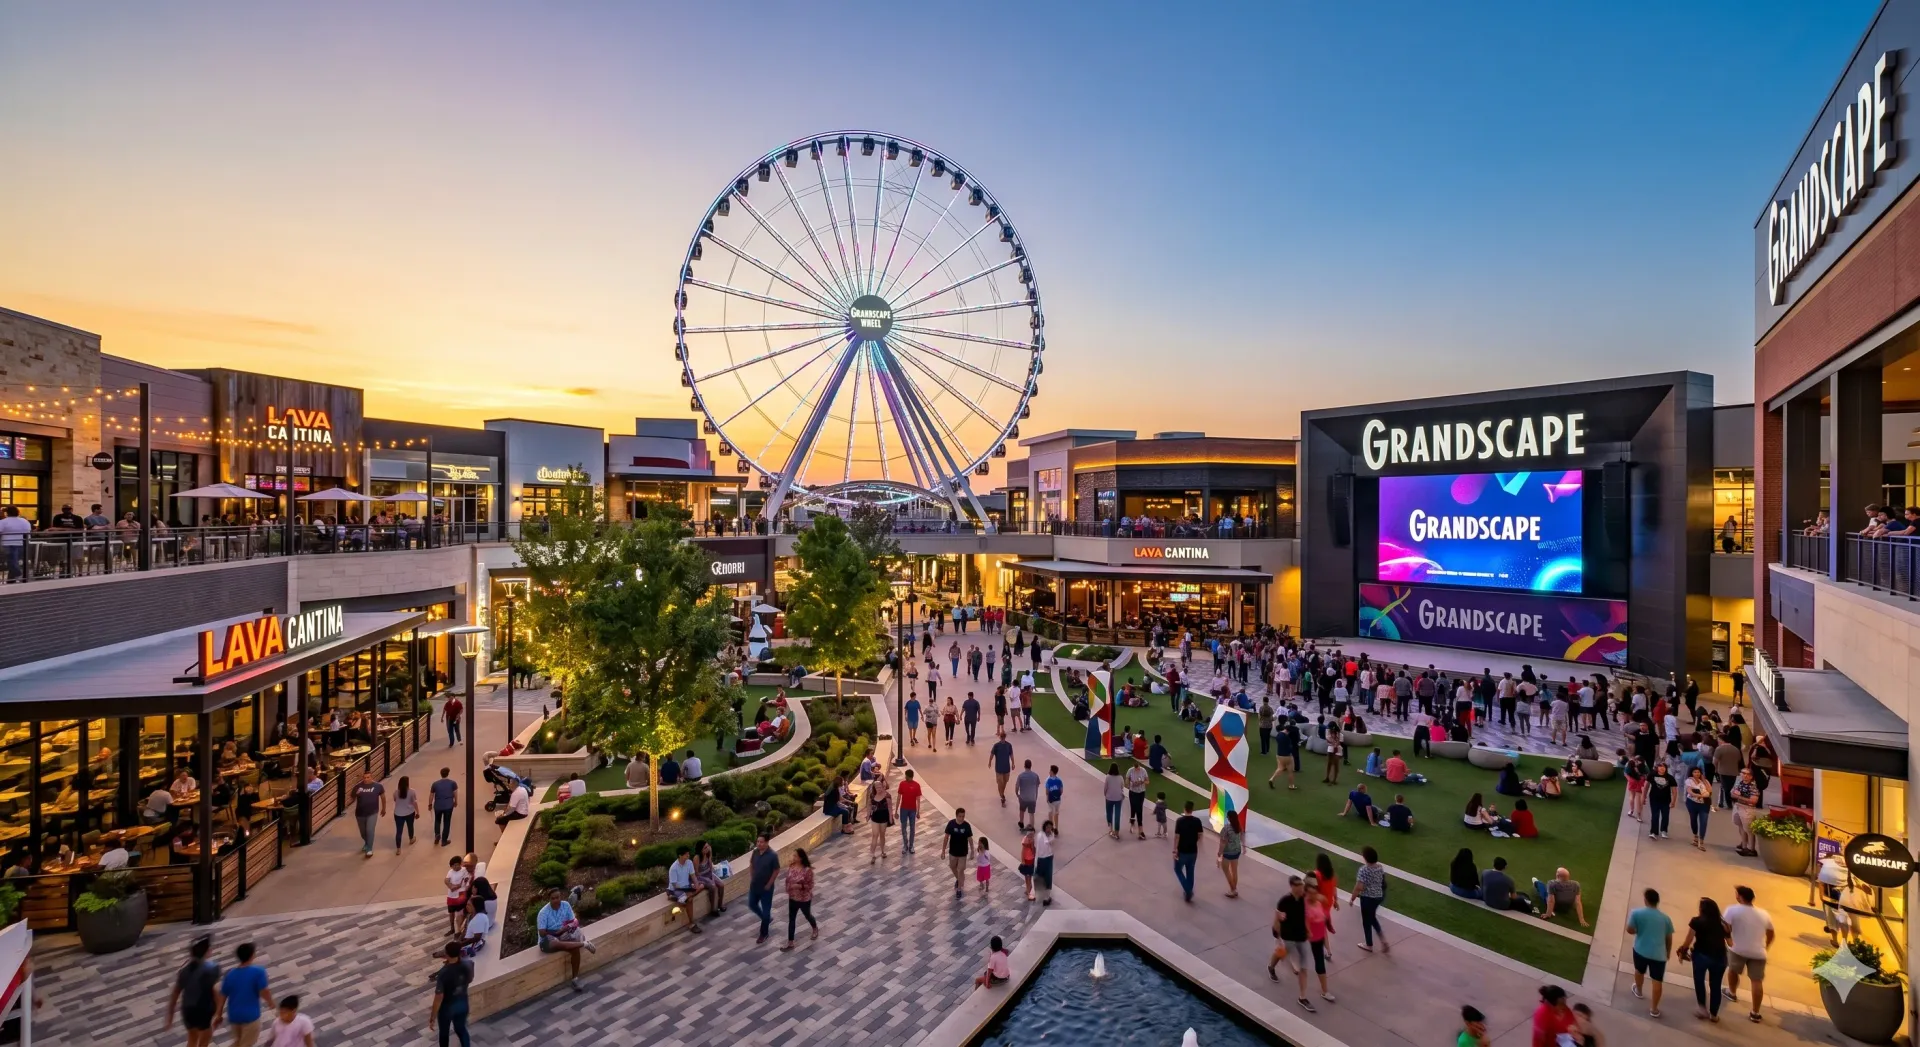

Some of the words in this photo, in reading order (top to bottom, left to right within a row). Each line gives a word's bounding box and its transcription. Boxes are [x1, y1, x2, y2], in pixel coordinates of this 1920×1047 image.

[1768, 50, 1896, 306] GRANDSCAPE
[860, 319, 881, 328] WHEEL
[267, 405, 331, 429] LAVA
[1363, 413, 1585, 470] GRANDSCAPE
[1409, 509, 1541, 542] GRANDSCAPE
[1134, 547, 1163, 558] LAVA
[1165, 547, 1209, 559] CANTINA
[1419, 599, 1543, 637] GRANDSCAPE
[203, 615, 284, 677] LAVA
[287, 605, 344, 649] CANTINA
[1853, 853, 1909, 871] GRANDSCAPE
